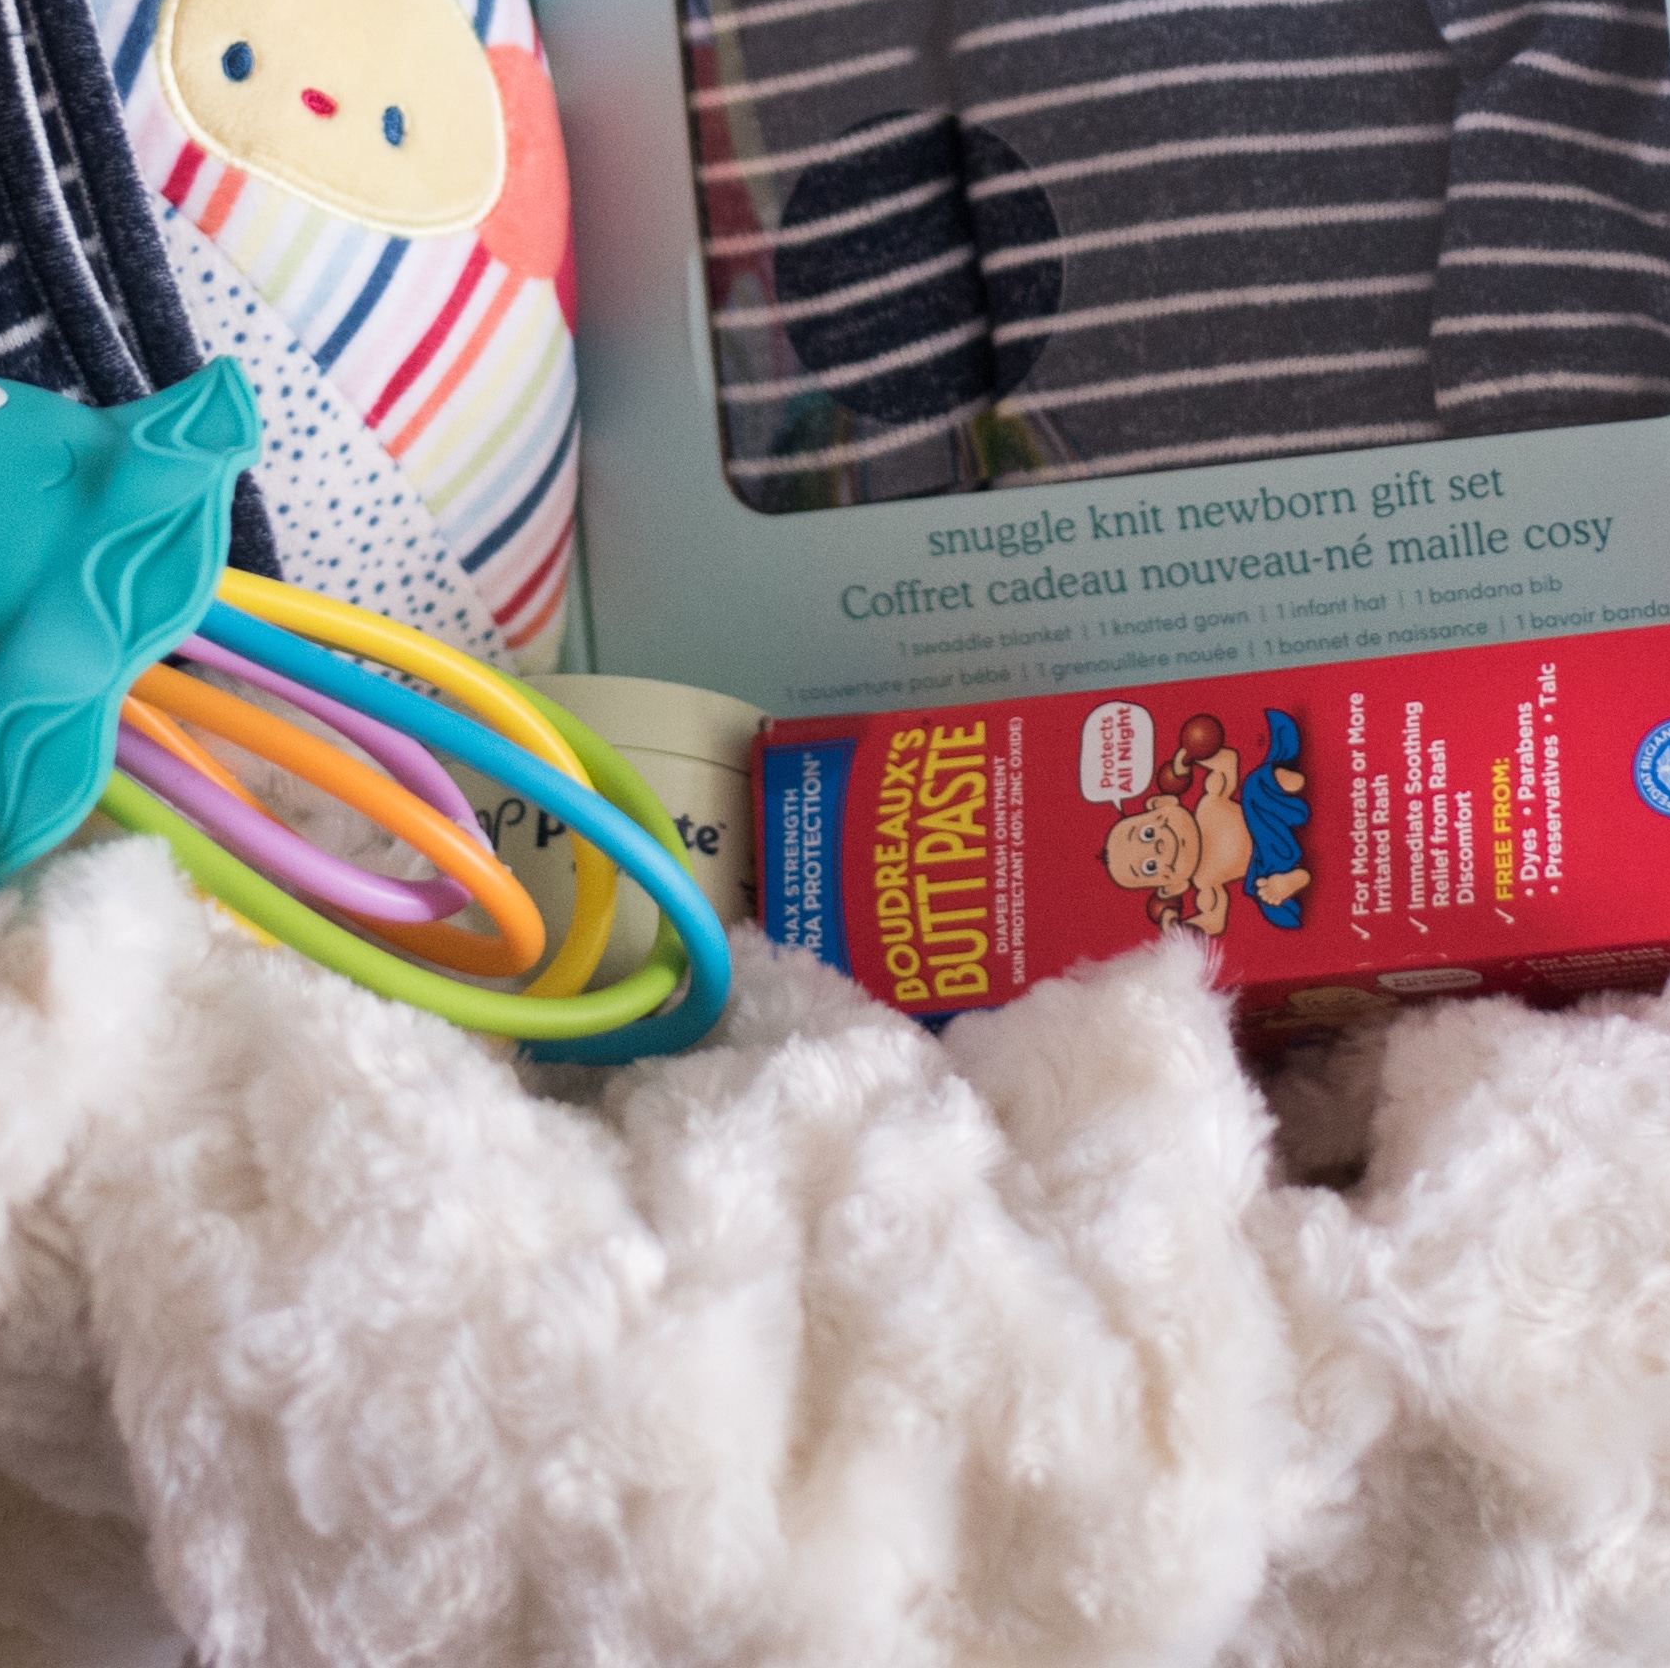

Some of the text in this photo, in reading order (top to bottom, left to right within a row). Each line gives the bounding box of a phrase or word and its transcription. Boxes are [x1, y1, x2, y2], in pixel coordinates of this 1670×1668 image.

[840, 516, 1613, 620] Coffret cadeau nouveau-né maille cosy
[928, 468, 1504, 559] snuggle knit newborn gift set
[999, 625, 1071, 648] blanket
[1112, 613, 1188, 636] knotted
[1194, 610, 1249, 631] gown
[1291, 597, 1348, 619] infant
[1354, 594, 1387, 612] hat
[1430, 581, 1524, 605] bandana
[1530, 575, 1564, 594] bib
[1280, 632, 1350, 654] bonnet
[1355, 629, 1382, 647] de
[1387, 620, 1489, 644] naissance
[1517, 613, 1524, 630] 1
[1530, 607, 1596, 629] bavoir
[1100, 715, 1114, 788] Protects
[1117, 705, 1135, 793] All Night
[1347, 691, 1369, 916] For Moderate or More
[1402, 701, 1426, 910] Immediate Soothing
[1515, 701, 1542, 882] Dyes Parabens
[1538, 662, 1563, 880] Preservatives Talc
[783, 788, 800, 898] STRENGTH
[874, 727, 929, 1002] BOUDREAUX'S
[914, 720, 989, 997] BUTT PASTE
[994, 755, 1009, 955] DIAPER RASH OINTMENT
[1009, 716, 1025, 985] SKIN PROTECTANT (40% ZINC OXIDE)
[1371, 773, 1392, 914] Irritated Rash
[1428, 739, 1451, 908] Relief from Rash
[1454, 790, 1476, 905] Discomfort
[1492, 757, 1514, 901] FREE FROM:
